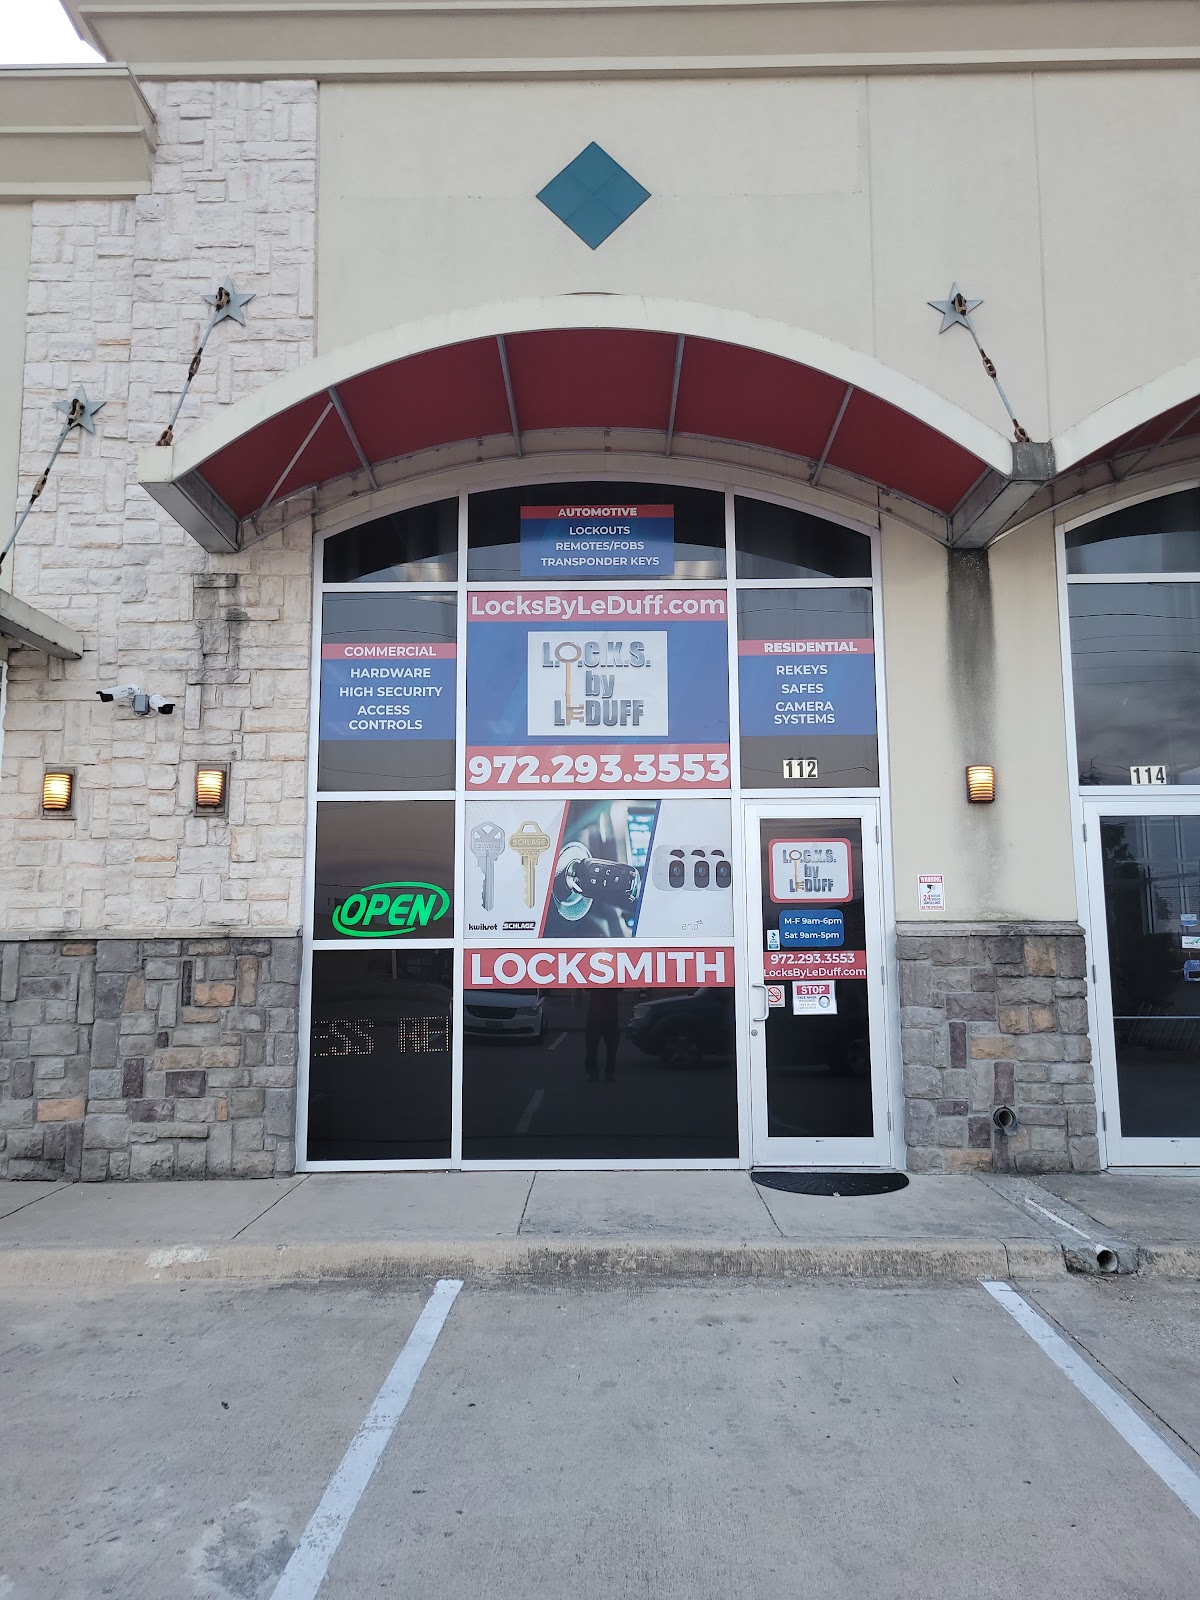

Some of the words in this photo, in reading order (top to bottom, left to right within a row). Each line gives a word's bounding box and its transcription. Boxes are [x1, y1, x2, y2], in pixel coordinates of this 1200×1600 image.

[558, 507, 638, 517] AUTOMOTIVE
[569, 526, 631, 536] LOCKOUTS
[555, 540, 645, 552] REMOTES/FOBS
[540, 557, 628, 567] TRANSPONDER
[630, 556, 660, 566] KEYS
[471, 594, 725, 620] LocksByLeDuff.com
[344, 646, 437, 657] COMMERCIAL
[763, 641, 858, 653] RESIDENTIAL
[350, 667, 432, 679] HARDWARE
[776, 664, 828, 676] REKEYS
[584, 670, 616, 699] by
[781, 683, 824, 694] SAFES
[339, 686, 374, 697] HIGH
[376, 686, 444, 697] SECURITY
[356, 705, 411, 716] ACCESS
[775, 701, 835, 712] CAMERA
[348, 719, 423, 730] CONTROLS
[773, 713, 836, 725] SYSTEMS
[468, 753, 730, 785] 972.293.3553
[785, 760, 817, 778] 112
[1133, 766, 1165, 784] 114
[804, 864, 820, 879] by
[340, 893, 438, 926] OPEN
[468, 923, 498, 931] kwikset
[502, 922, 536, 930] SCHLAGE
[784, 917, 800, 925] M-F
[801, 917, 842, 927] 9am-6pm
[784, 931, 798, 939] Sat
[799, 931, 840, 940] 9am-5pm
[770, 952, 856, 965] 972.293.3553
[471, 951, 726, 985] LOCKSMITH
[764, 966, 866, 979] LocksByLeDuff.com
[801, 985, 826, 995] STOP
